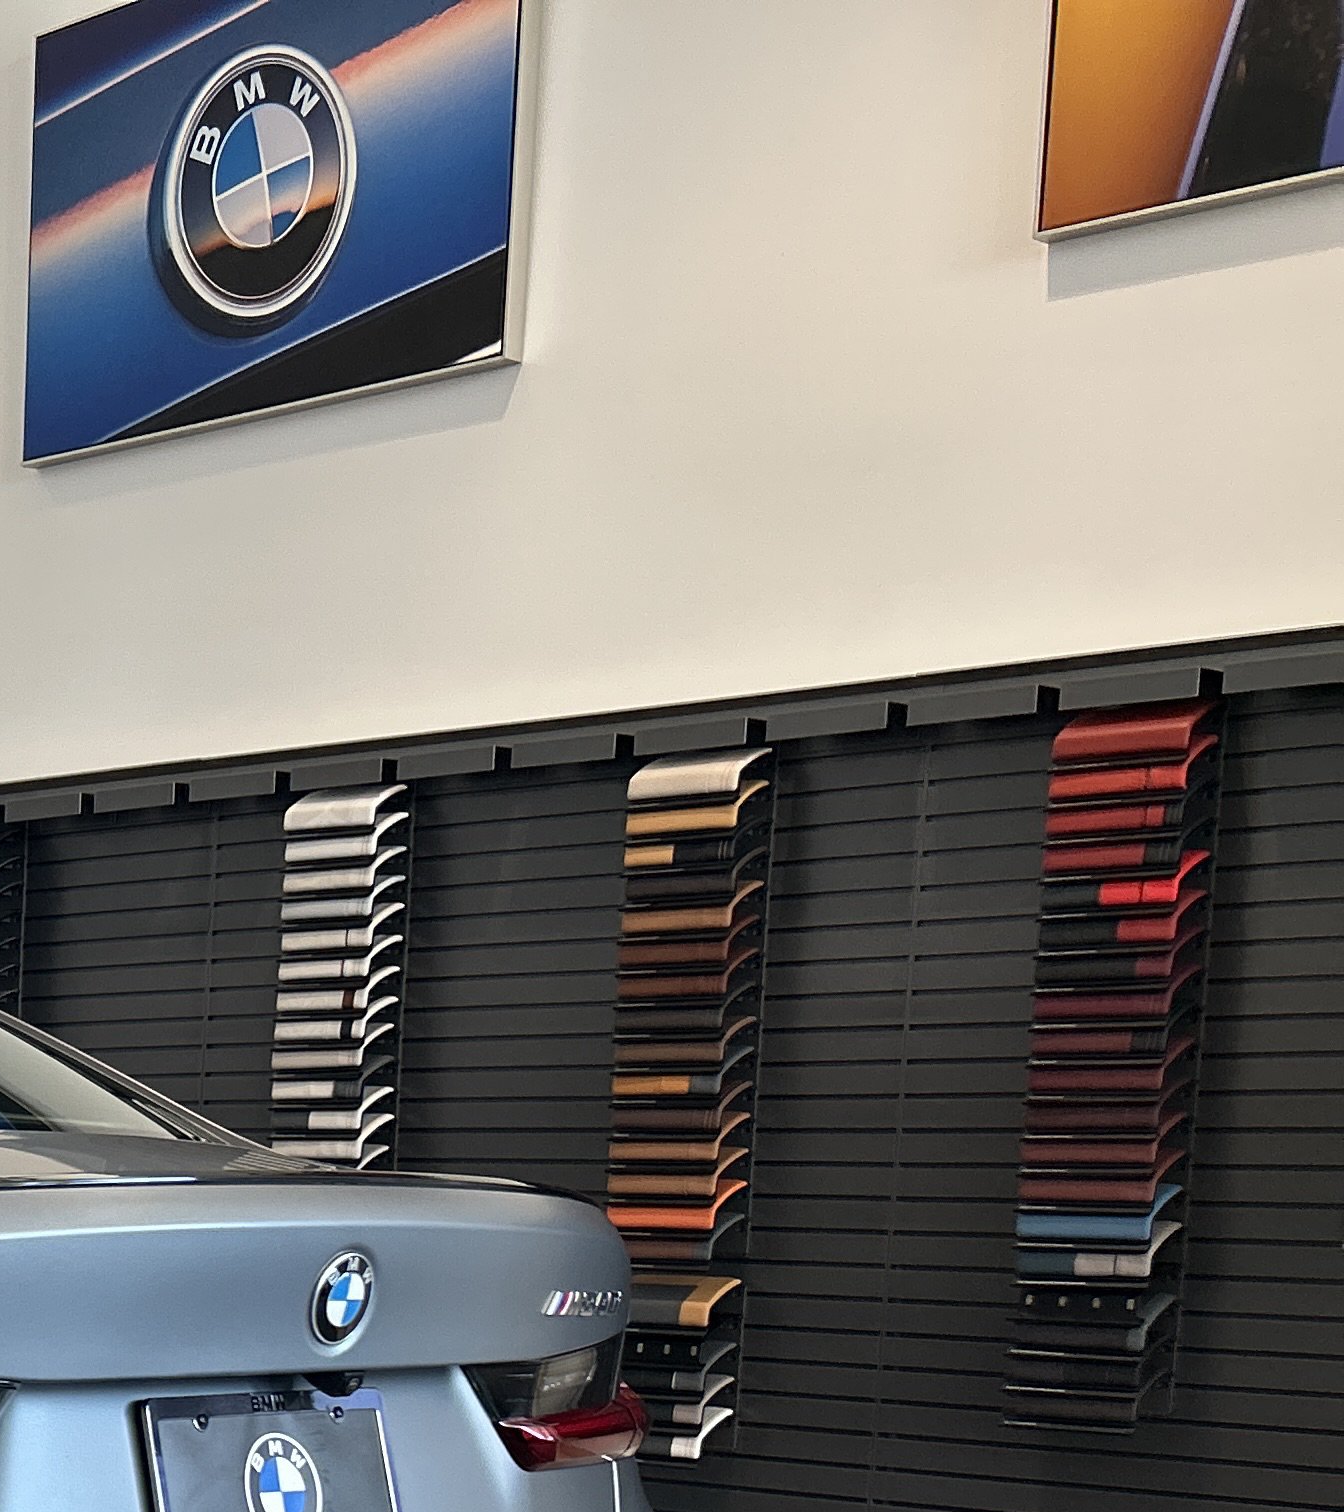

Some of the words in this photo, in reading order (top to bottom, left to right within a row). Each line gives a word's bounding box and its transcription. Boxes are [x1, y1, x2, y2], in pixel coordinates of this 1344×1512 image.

[190, 70, 320, 166] BMW
[327, 1255, 373, 1286] BMW
[250, 1439, 307, 1473] BMW
